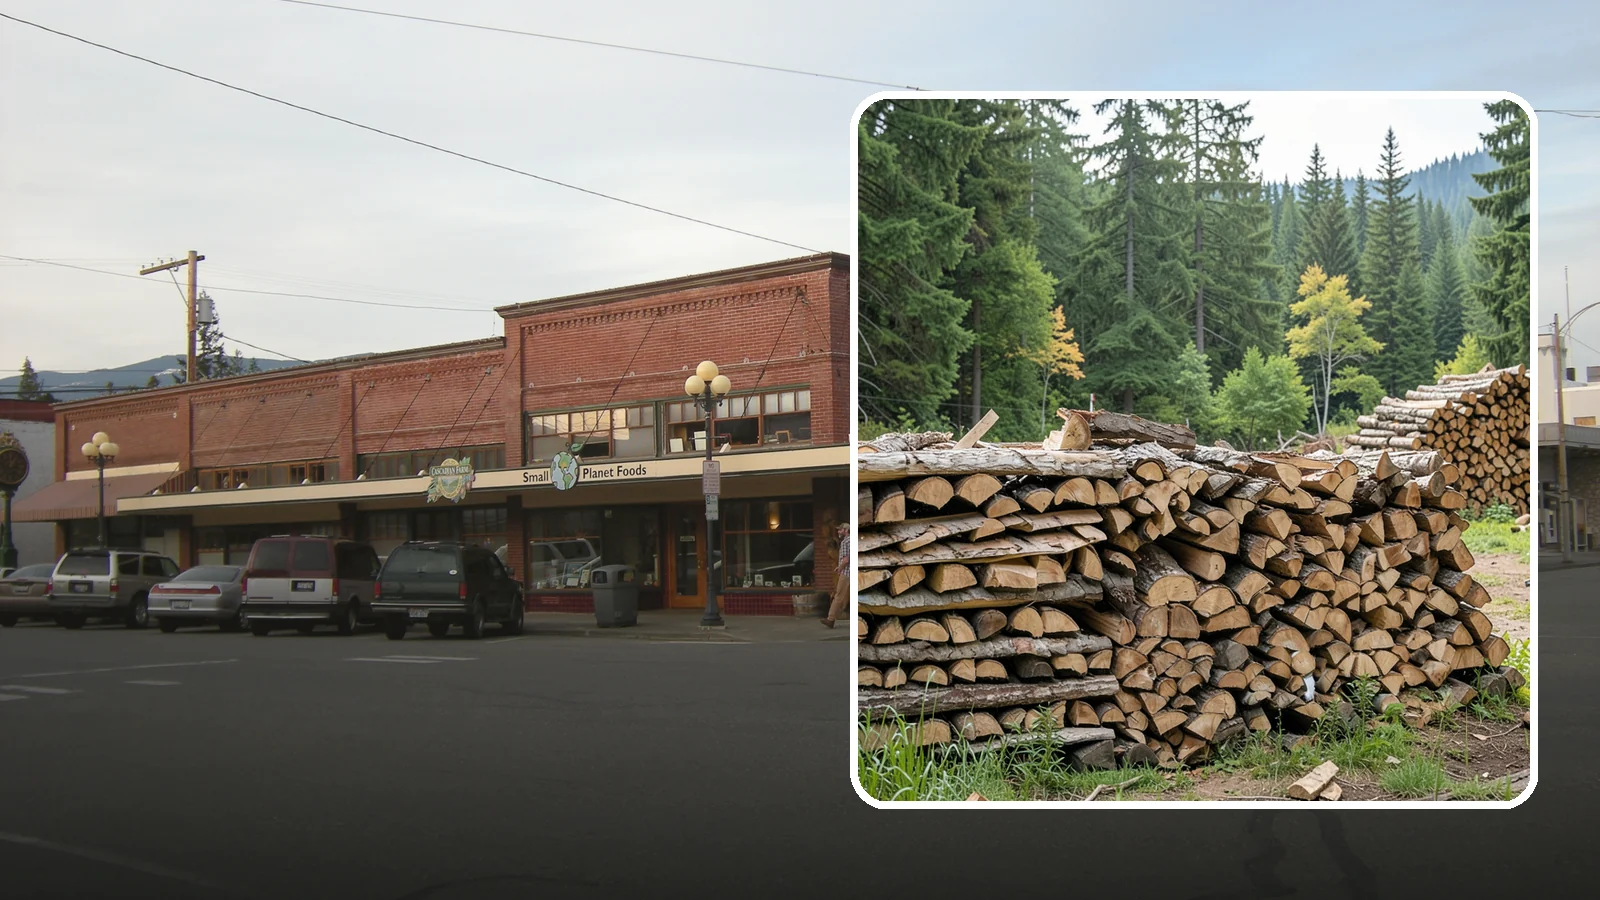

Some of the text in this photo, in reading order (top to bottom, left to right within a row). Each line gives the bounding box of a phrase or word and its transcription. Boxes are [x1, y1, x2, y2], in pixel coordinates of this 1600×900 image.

[523, 464, 647, 483] Small Planet Foods
